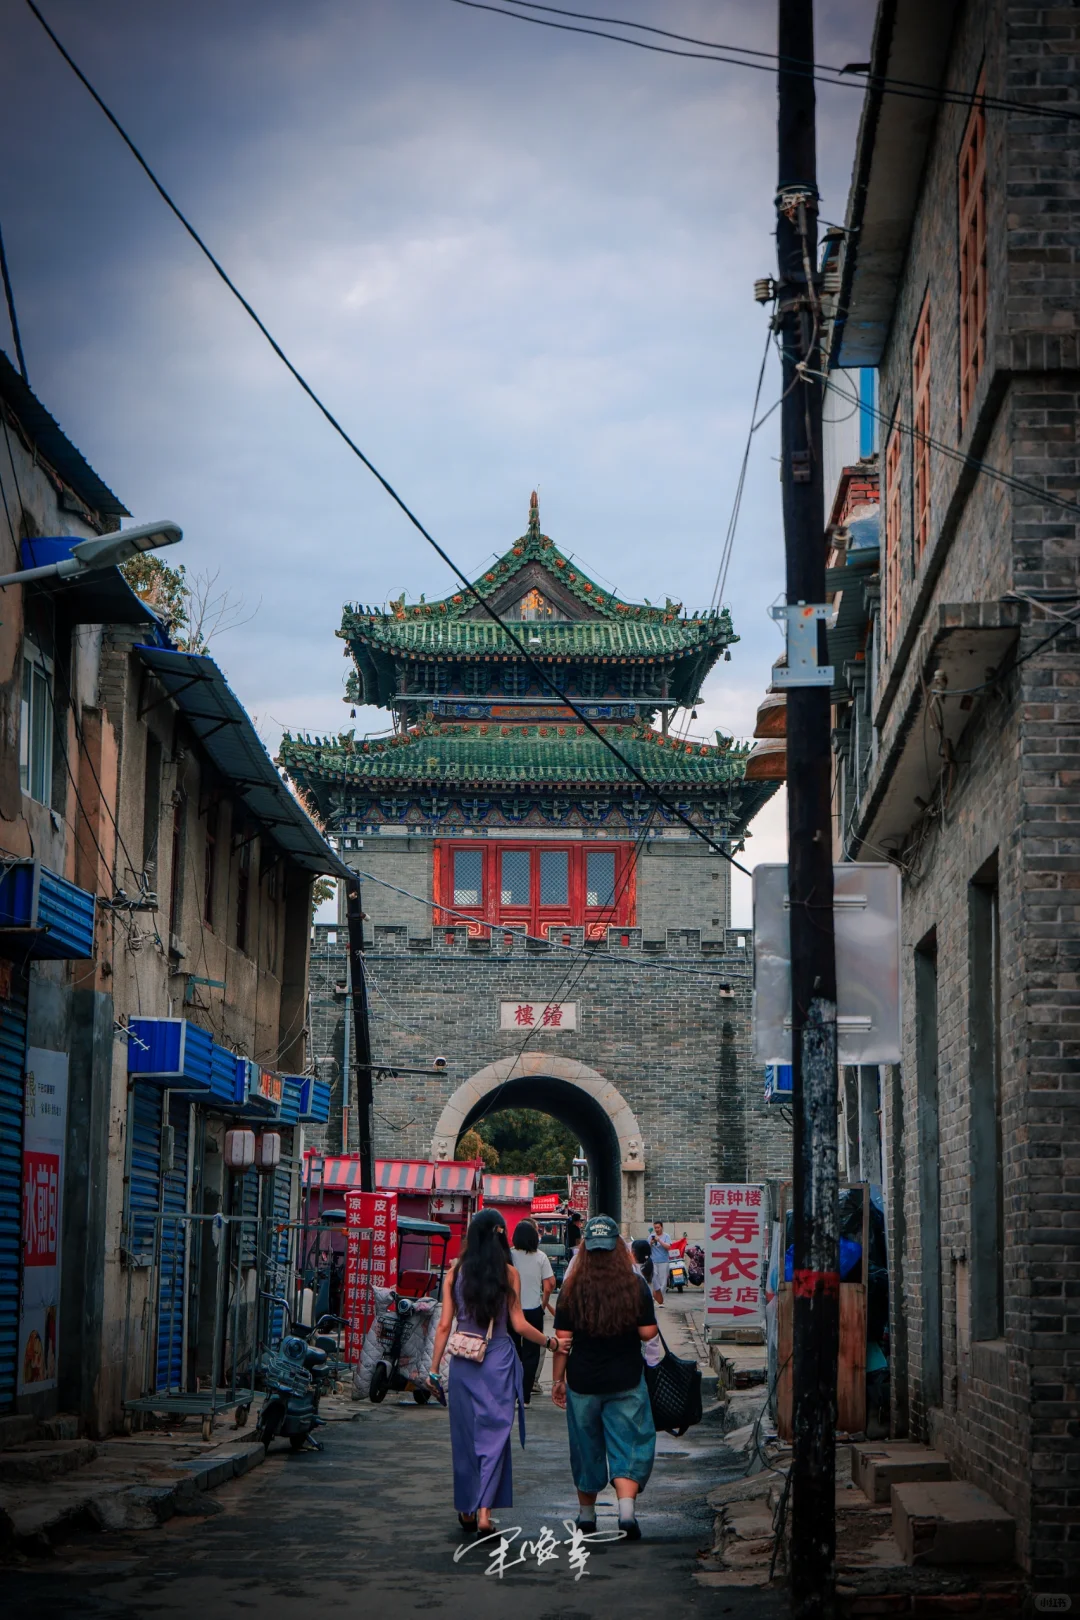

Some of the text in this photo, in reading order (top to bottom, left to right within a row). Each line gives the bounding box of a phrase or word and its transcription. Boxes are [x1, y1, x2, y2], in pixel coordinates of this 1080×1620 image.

[709, 1189, 762, 1207] 原钟楼
[709, 1209, 760, 1283] 寿衣
[348, 1258, 387, 1272] 刀削面
[347, 1273, 386, 1288] 麻辣粉
[347, 1288, 376, 1302] 麻辣
[709, 1286, 759, 1303] 老店
[347, 1304, 376, 1316] 土豆
